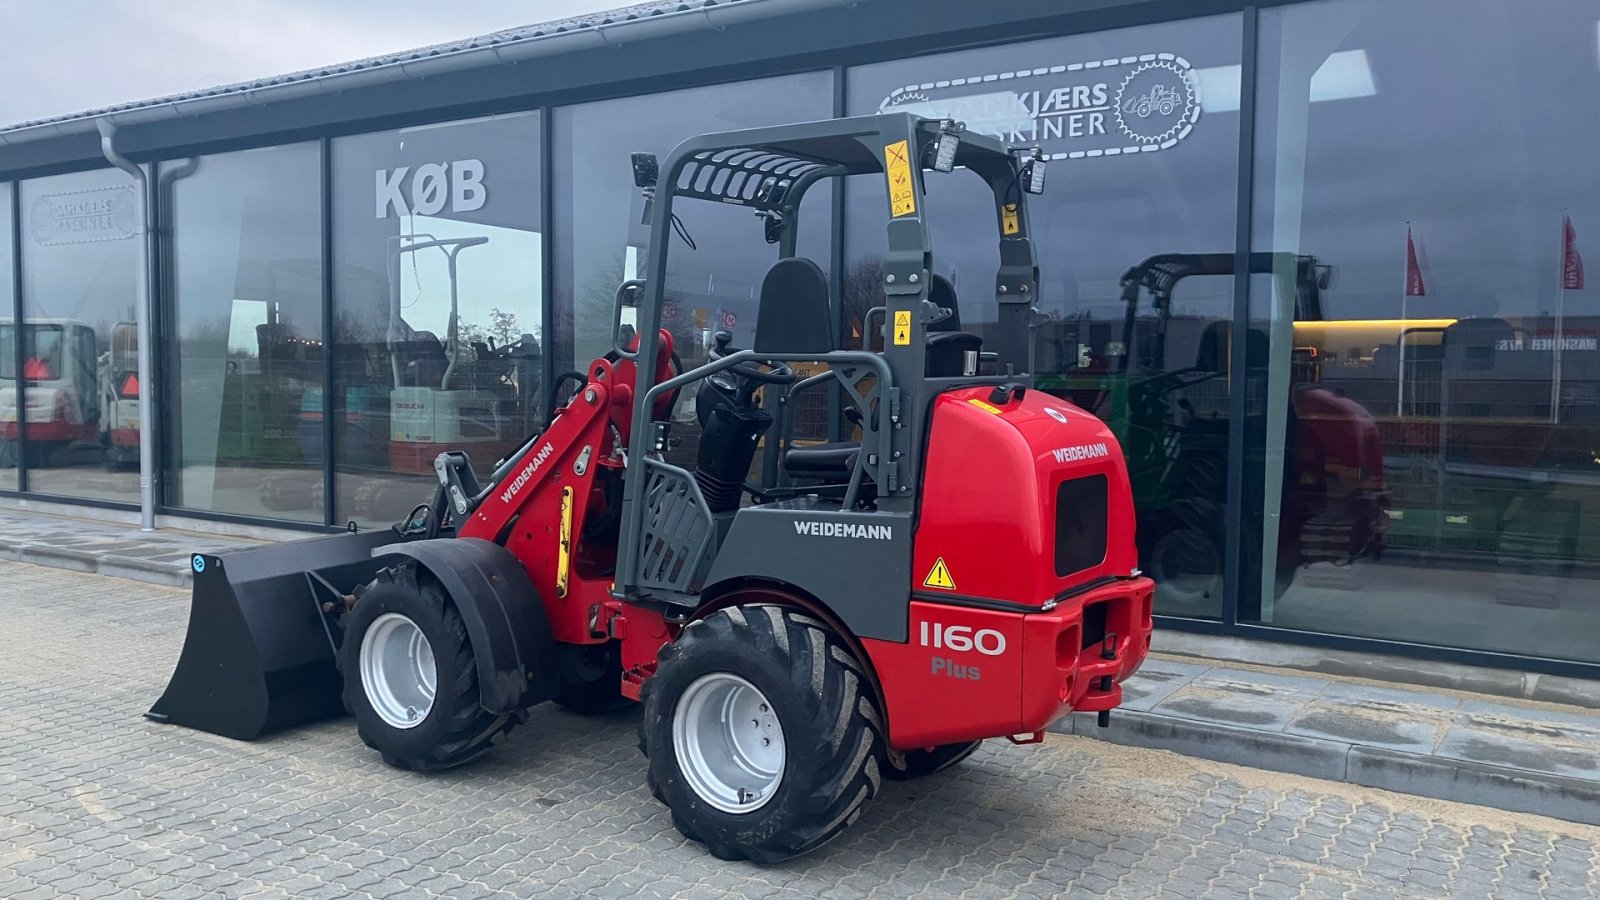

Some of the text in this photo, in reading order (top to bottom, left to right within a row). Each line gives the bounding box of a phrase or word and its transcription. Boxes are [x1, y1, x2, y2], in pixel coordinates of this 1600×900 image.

[990, 82, 1109, 120] KJÆRS
[375, 158, 487, 219] KØB
[1052, 443, 1108, 463] WEIDEMANN
[500, 441, 554, 504] WEIDEMANN
[794, 520, 892, 540] WEIDEMANN
[920, 621, 1006, 656] 1160
[931, 656, 981, 680] Plus
